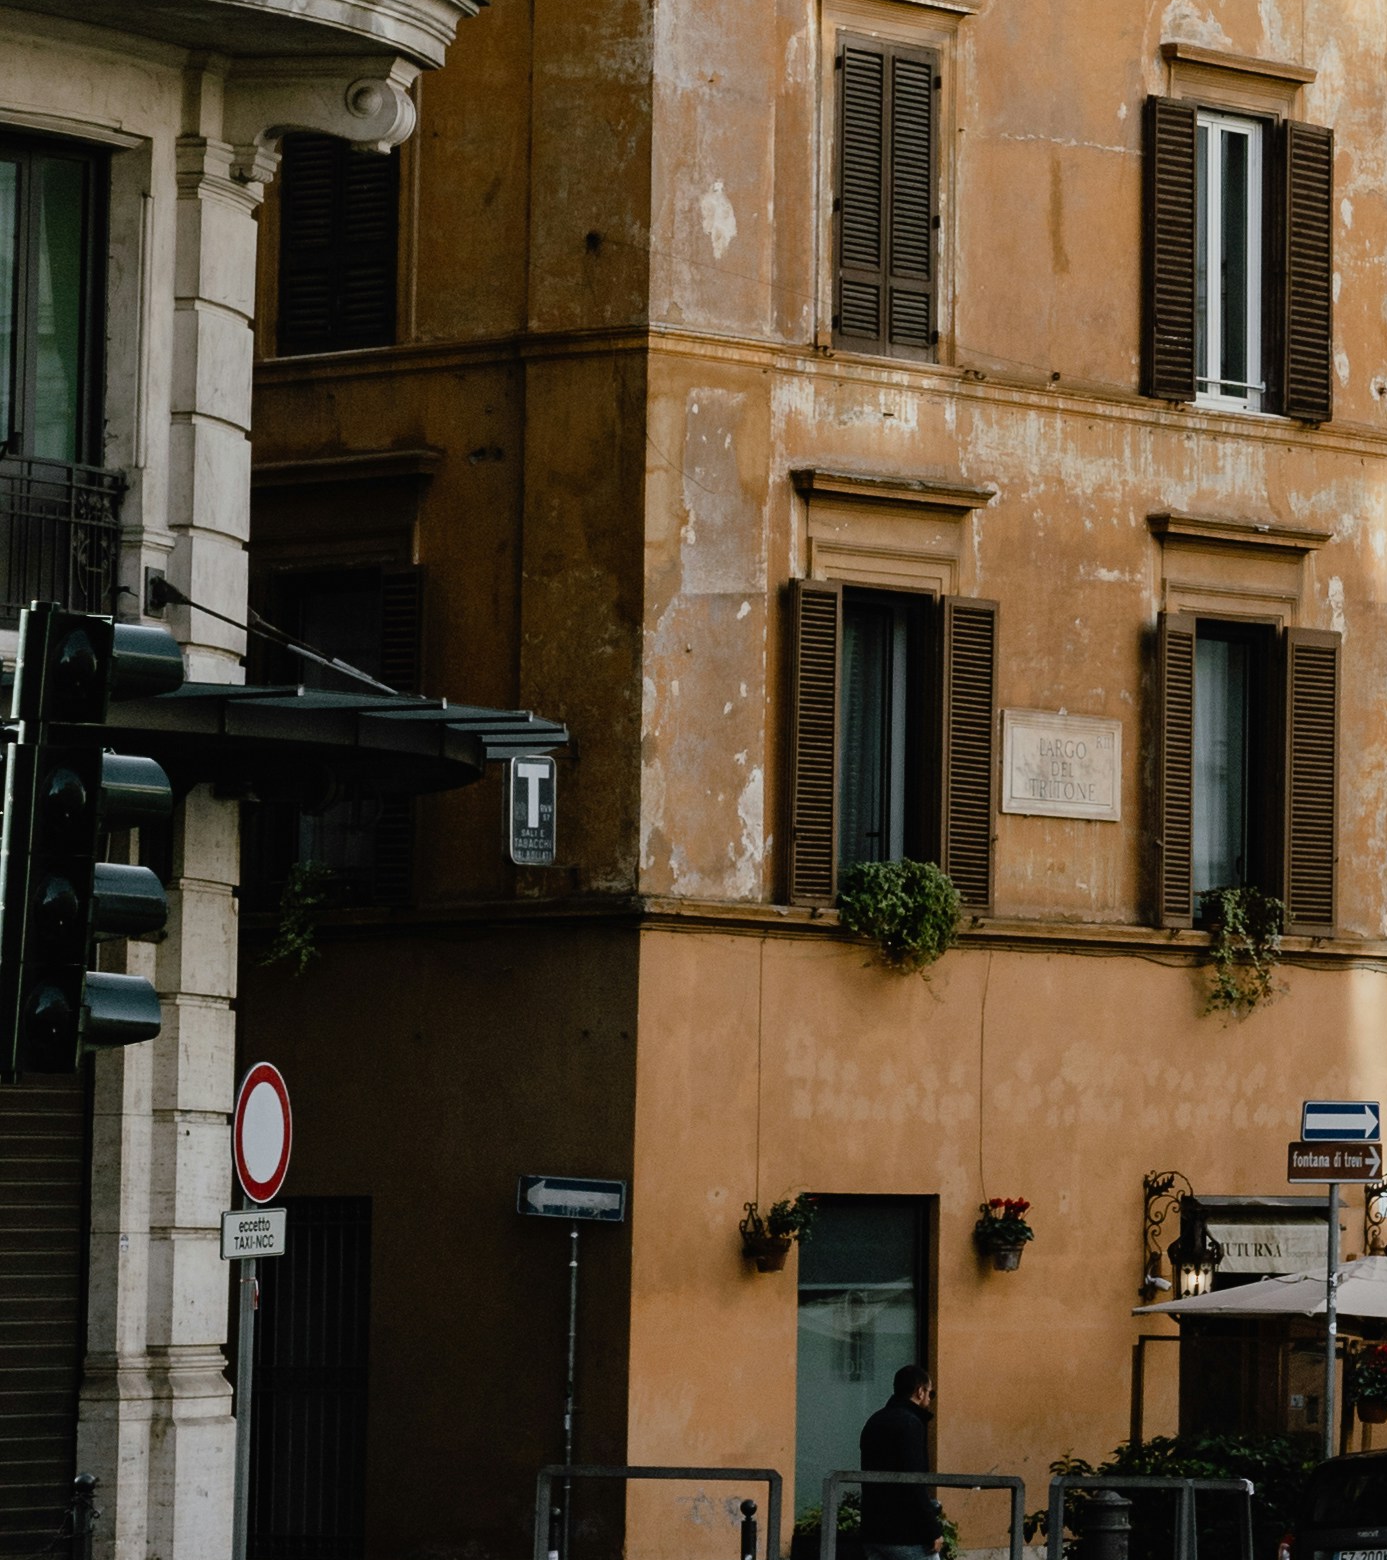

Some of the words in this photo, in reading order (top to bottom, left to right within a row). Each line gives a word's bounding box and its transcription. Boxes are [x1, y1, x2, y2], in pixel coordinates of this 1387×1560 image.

[1039, 738, 1087, 759] LARGO
[1051, 761, 1074, 777] DEL
[517, 764, 550, 828] T
[1029, 778, 1097, 801] TRITONE
[521, 829, 538, 837] SALI
[514, 837, 552, 849] TABACCHI
[1292, 1151, 1330, 1168] fontana
[1333, 1151, 1342, 1168] di
[1344, 1152, 1363, 1168] trevi
[238, 1217, 271, 1232] eccetto
[234, 1234, 274, 1250] TAXI-NCC
